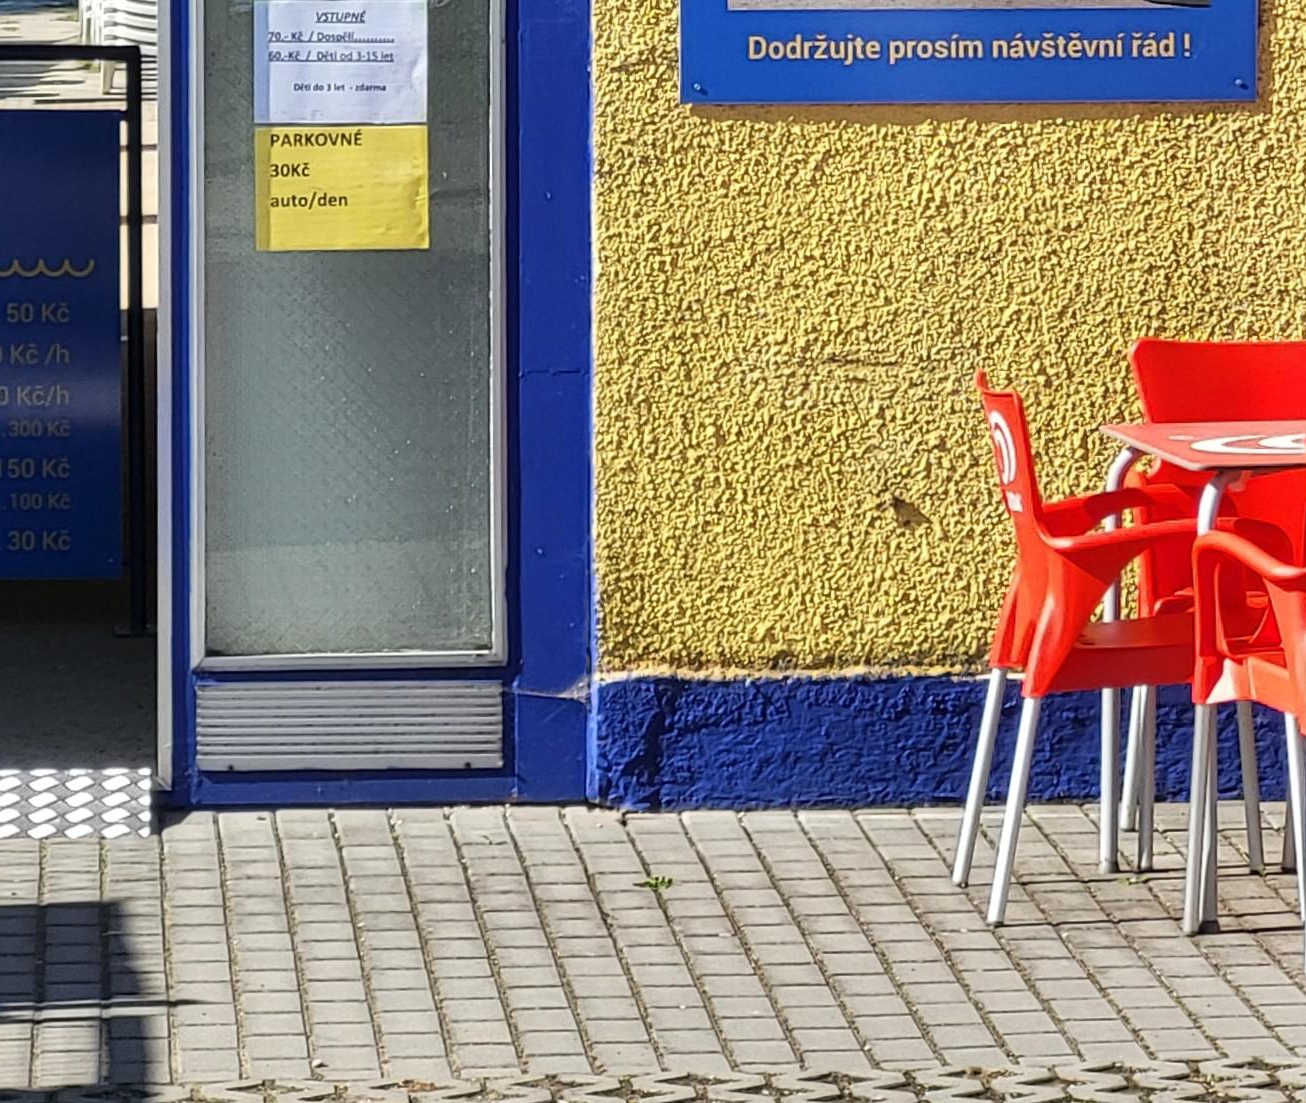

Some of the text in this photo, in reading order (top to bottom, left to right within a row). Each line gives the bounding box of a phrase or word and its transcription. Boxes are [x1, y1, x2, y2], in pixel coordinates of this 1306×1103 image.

[315, 10, 366, 23] VSTUPNÉ
[317, 51, 337, 62] Děti
[748, 31, 1190, 64] Dodržujte prosím návštěvní řád !
[313, 82, 324, 92] do
[326, 83, 331, 92] 3
[355, 82, 387, 92] zdarma
[270, 129, 363, 147] PARKOVNÉ
[270, 162, 310, 178] 30Kč
[270, 191, 348, 210] auto/den
[5, 303, 34, 324] 50
[41, 302, 70, 324] Kč
[9, 341, 39, 365] Kč
[45, 343, 70, 366] /h
[16, 384, 70, 408] Kč/h
[8, 420, 43, 438] 300
[46, 419, 71, 438] Kč
[41, 456, 70, 479] Kč
[9, 493, 43, 511] 100
[47, 492, 71, 512] Kč
[7, 532, 35, 552] 30
[41, 529, 71, 552] Kč
